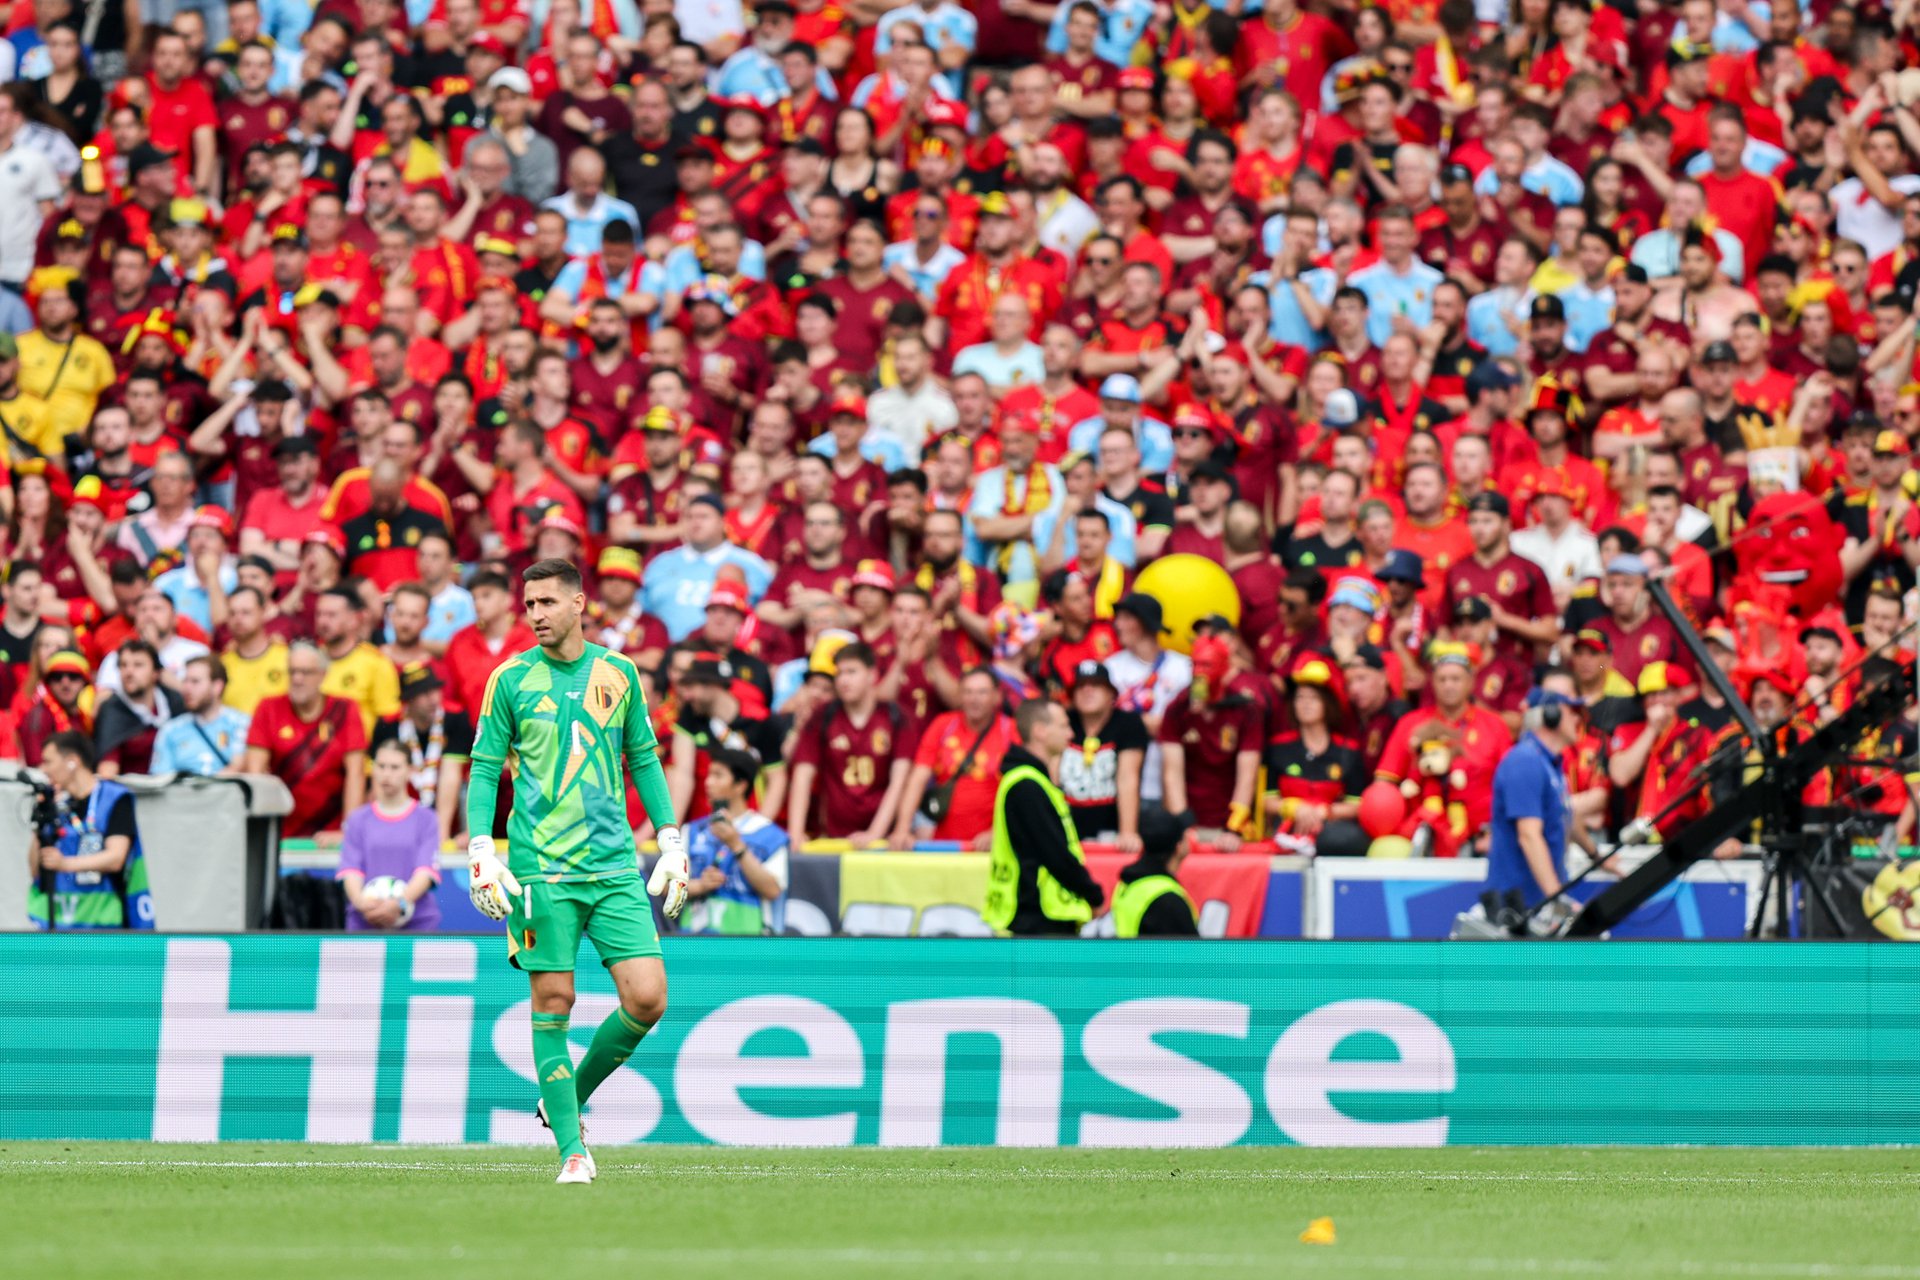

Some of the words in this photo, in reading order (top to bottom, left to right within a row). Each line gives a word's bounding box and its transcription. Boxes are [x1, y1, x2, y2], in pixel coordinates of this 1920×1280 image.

[676, 580, 710, 606] 22
[571, 719, 582, 756] 1
[843, 755, 875, 786] 20
[524, 884, 532, 919] 1
[152, 938, 1457, 1147] Hisense
